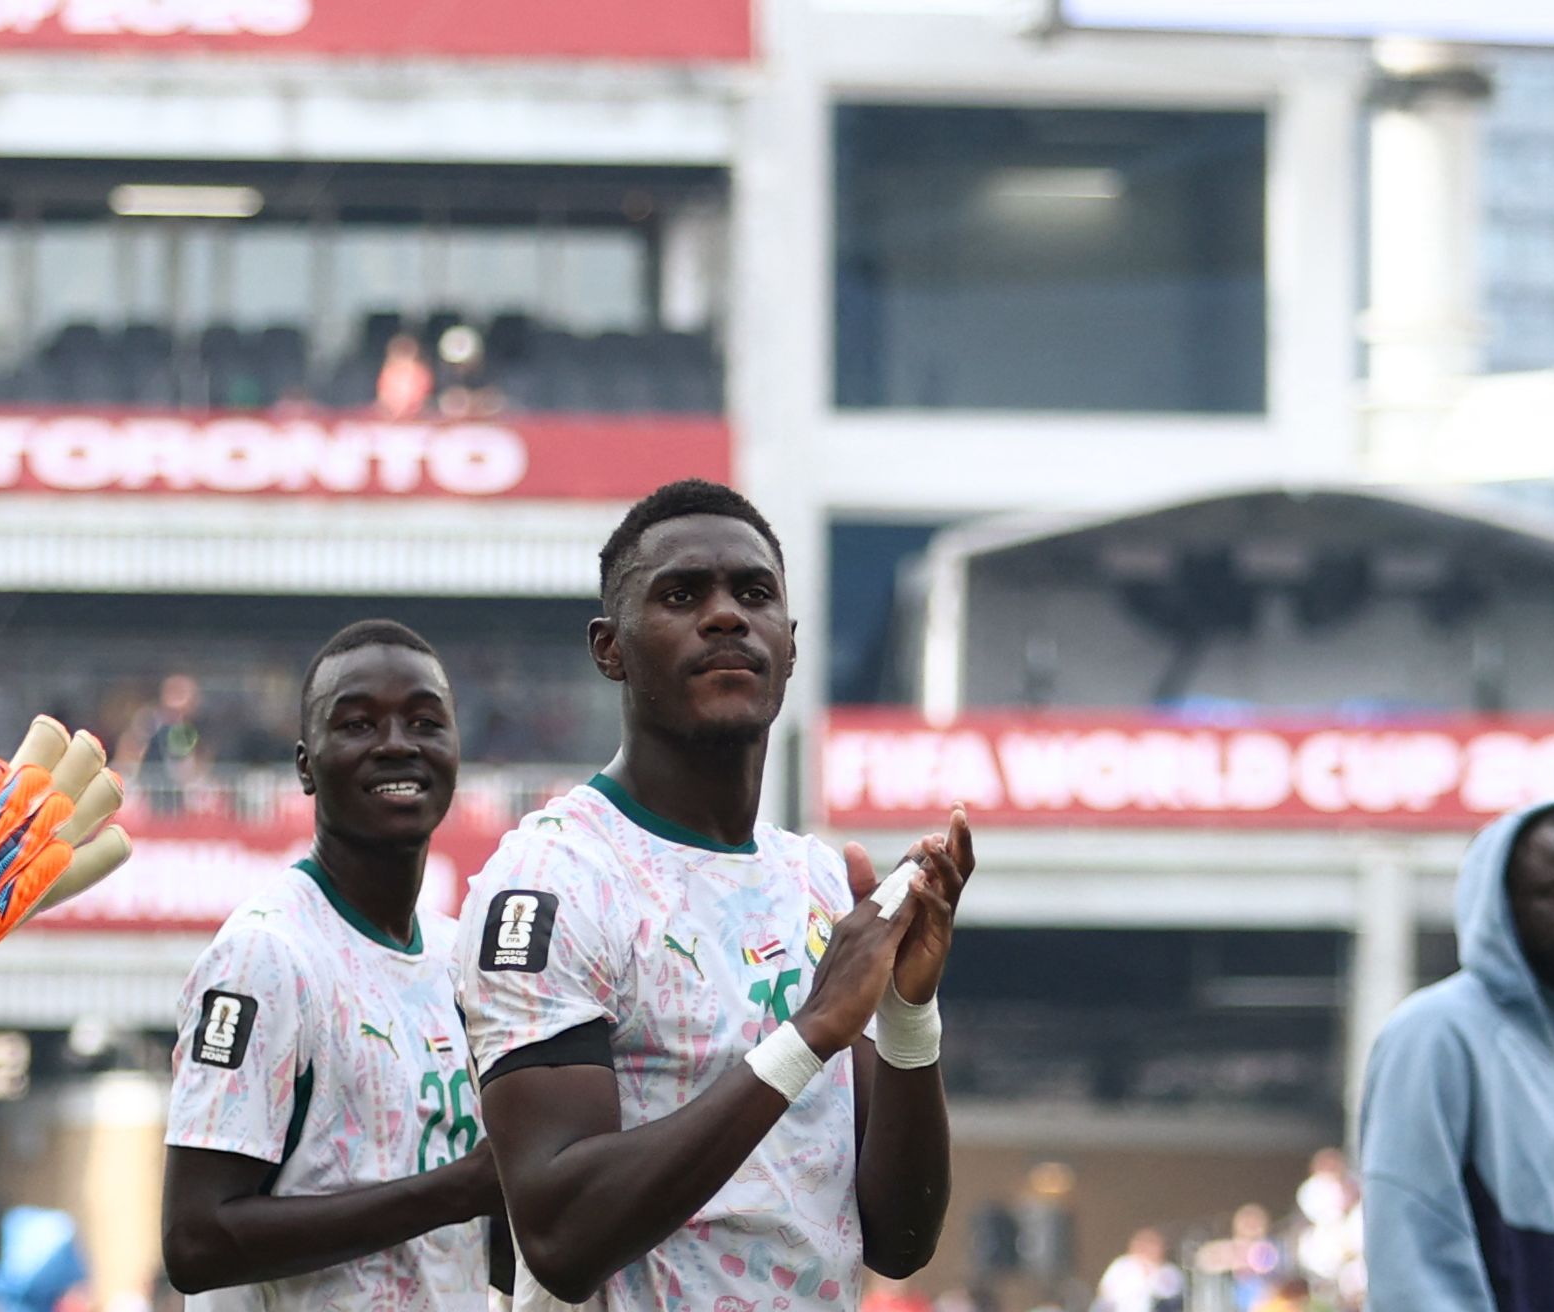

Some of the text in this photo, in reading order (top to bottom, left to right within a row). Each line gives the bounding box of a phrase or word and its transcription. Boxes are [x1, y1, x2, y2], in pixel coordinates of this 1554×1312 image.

[824, 733, 998, 808] FIFA
[999, 733, 1289, 810] WORLD
[1291, 734, 1459, 813] CUP
[494, 956, 527, 965] 2026
[418, 1069, 478, 1173] 26
